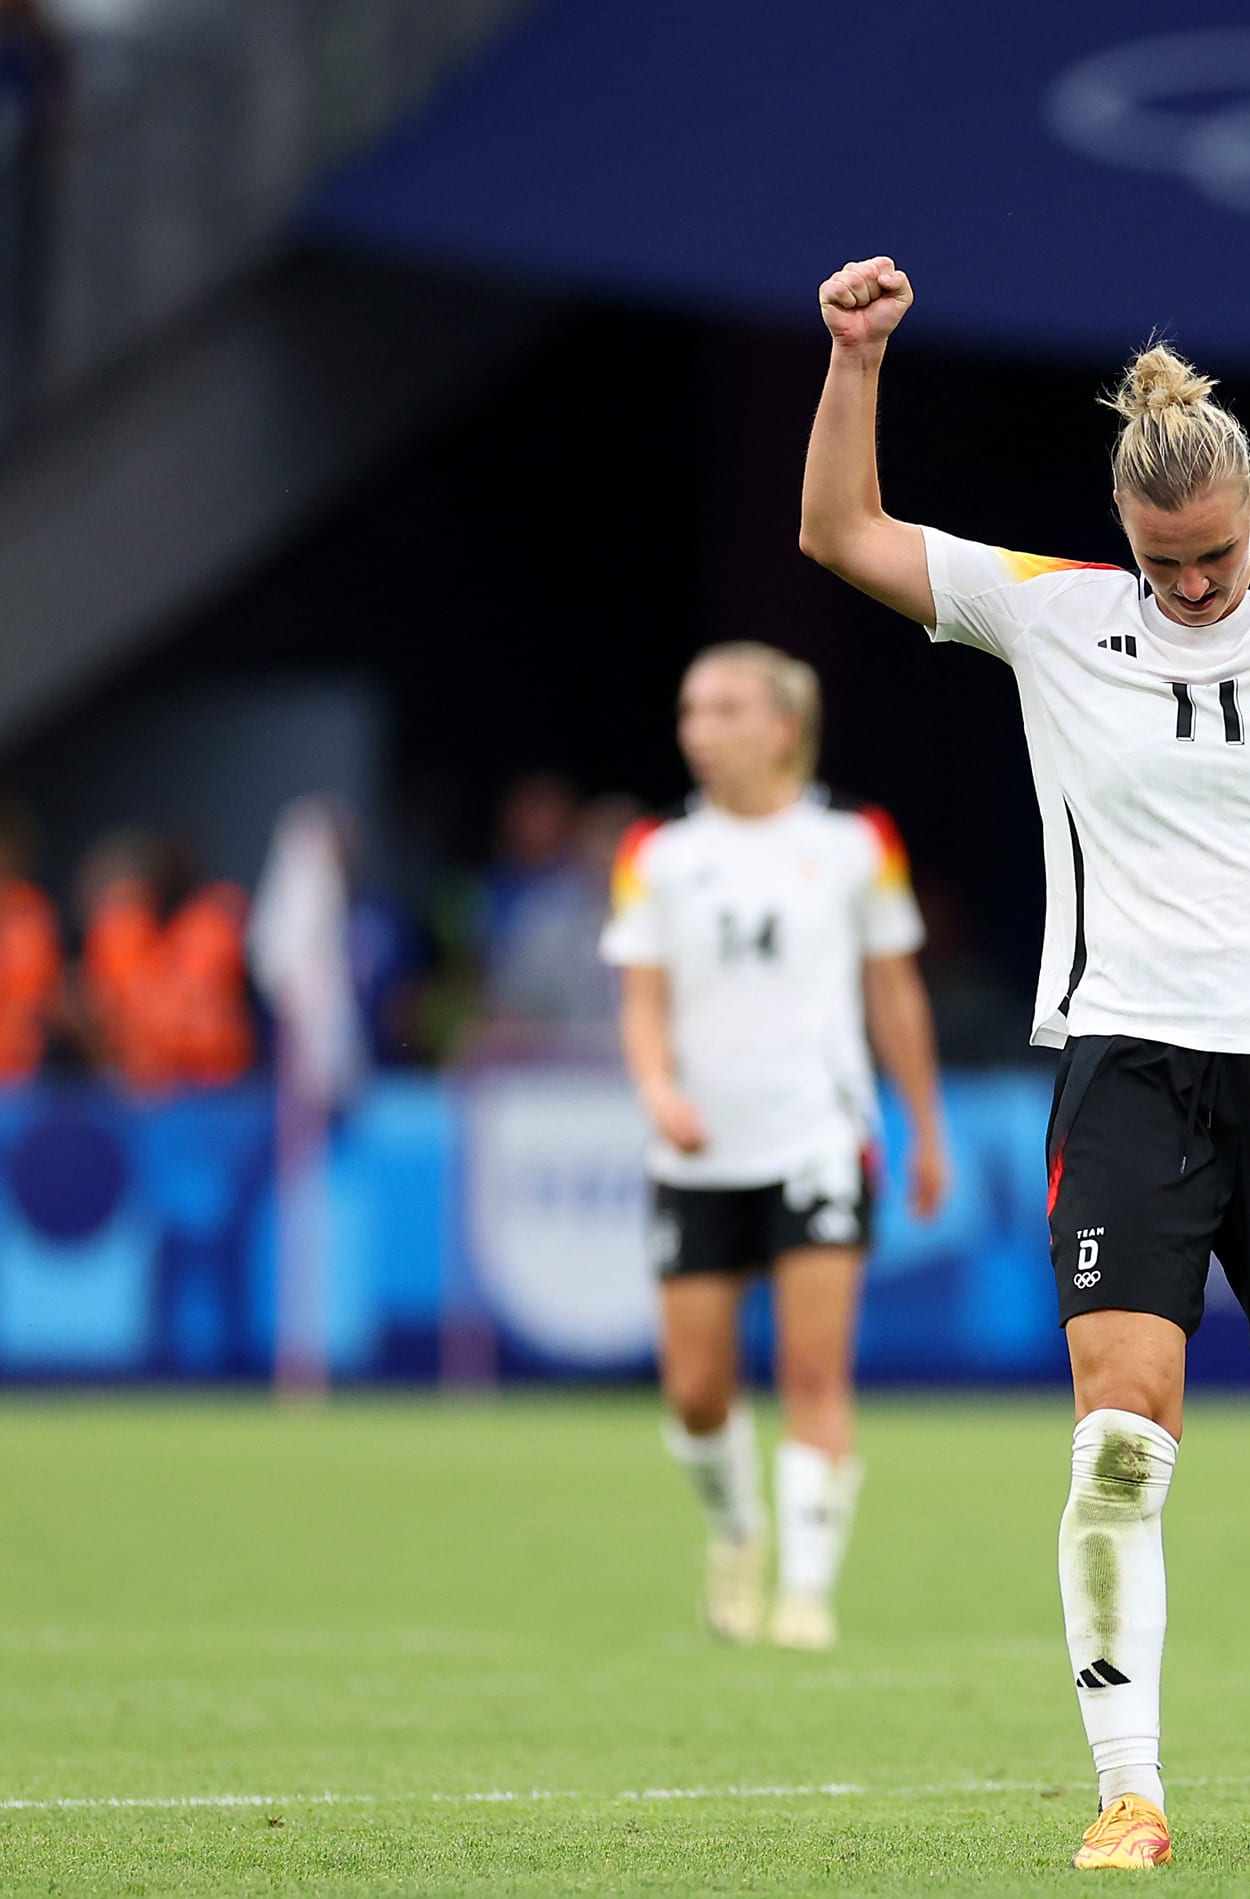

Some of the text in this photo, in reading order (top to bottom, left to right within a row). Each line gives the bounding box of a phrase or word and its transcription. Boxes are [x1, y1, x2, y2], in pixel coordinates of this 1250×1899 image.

[1170, 679, 1245, 745] 11
[716, 905, 783, 963] 14
[1076, 1226, 1105, 1239] TEAM
[1078, 1239, 1099, 1270] D
